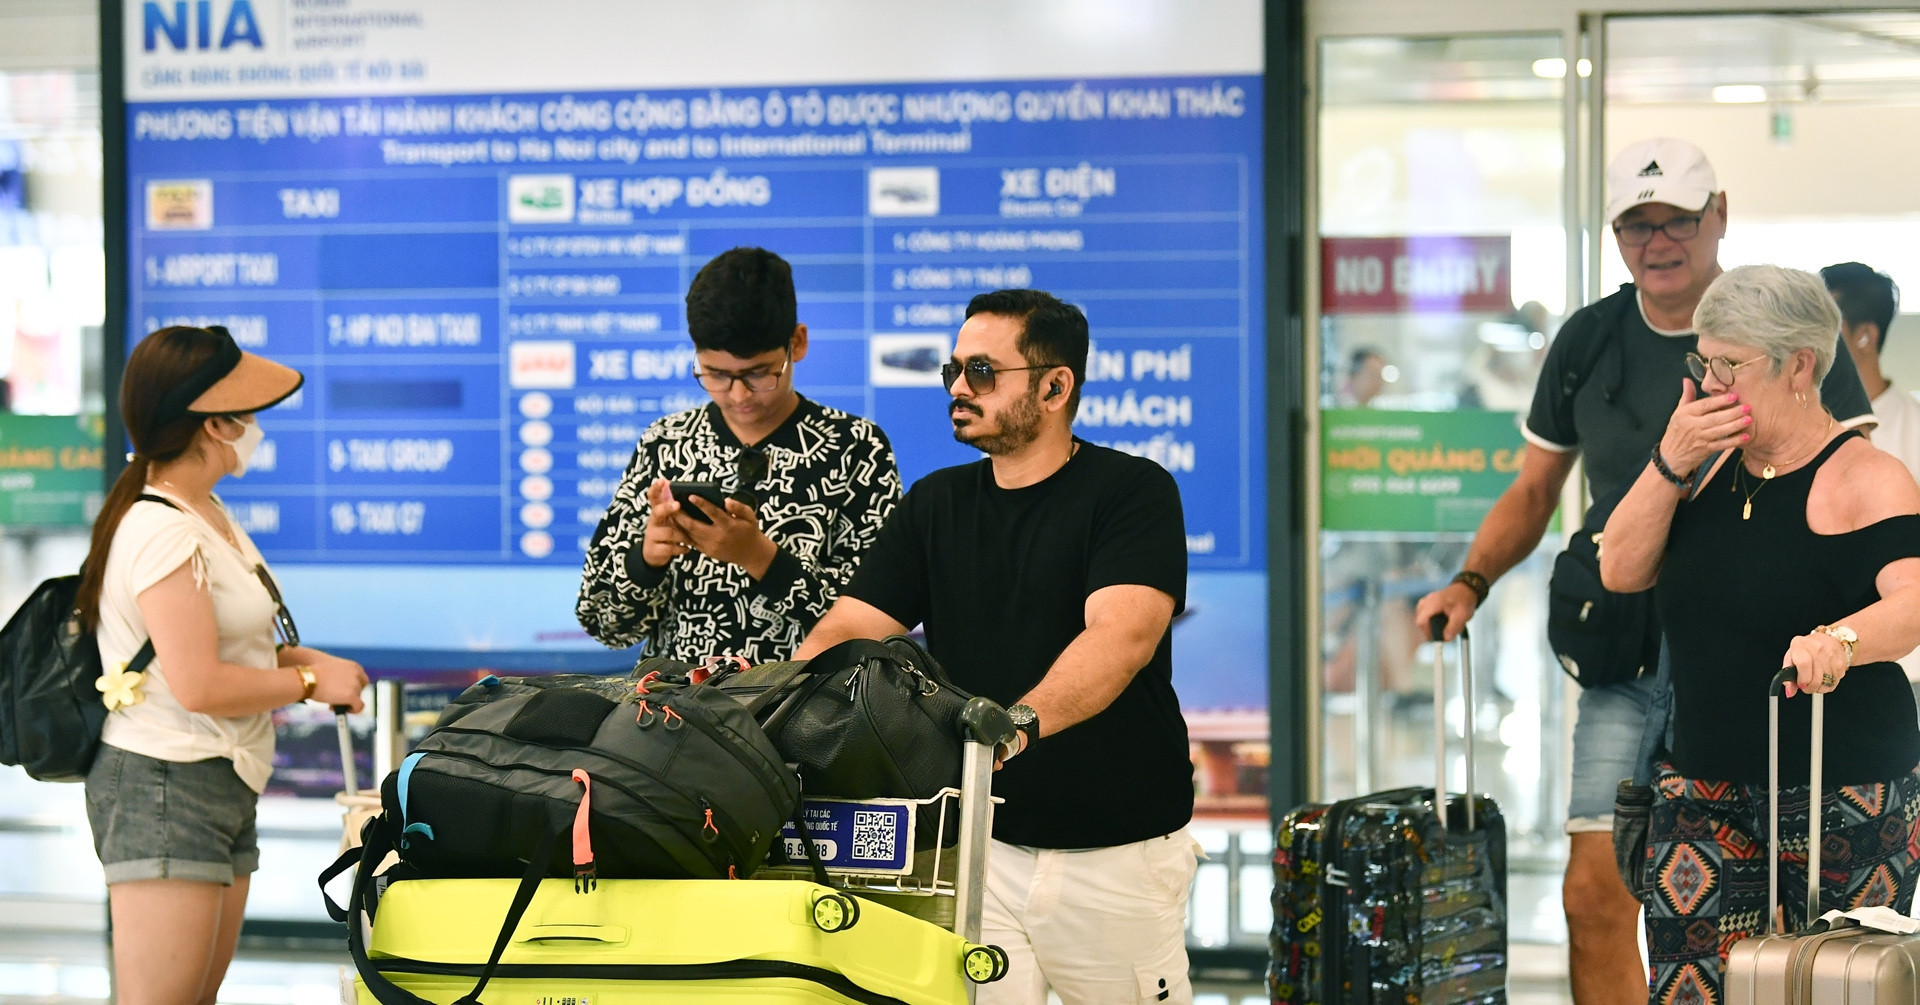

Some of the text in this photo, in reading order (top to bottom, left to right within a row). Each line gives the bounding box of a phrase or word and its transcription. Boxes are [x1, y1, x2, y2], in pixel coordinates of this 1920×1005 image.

[143, 0, 264, 51] NIA
[381, 137, 489, 167] Transport
[491, 138, 516, 163] to
[518, 136, 552, 162] Ha
[597, 134, 642, 164] city
[644, 132, 690, 159] and
[691, 133, 718, 158] to
[720, 131, 866, 157] International
[868, 129, 971, 154] Terminal
[580, 178, 617, 208] XE
[1001, 162, 1116, 202] XE ĐIỆN
[280, 188, 339, 218] TAXI
[237, 253, 278, 285] TAXI
[1334, 255, 1500, 296] NO ENTRY
[589, 350, 628, 380] XE
[1131, 343, 1192, 381] PHÍ
